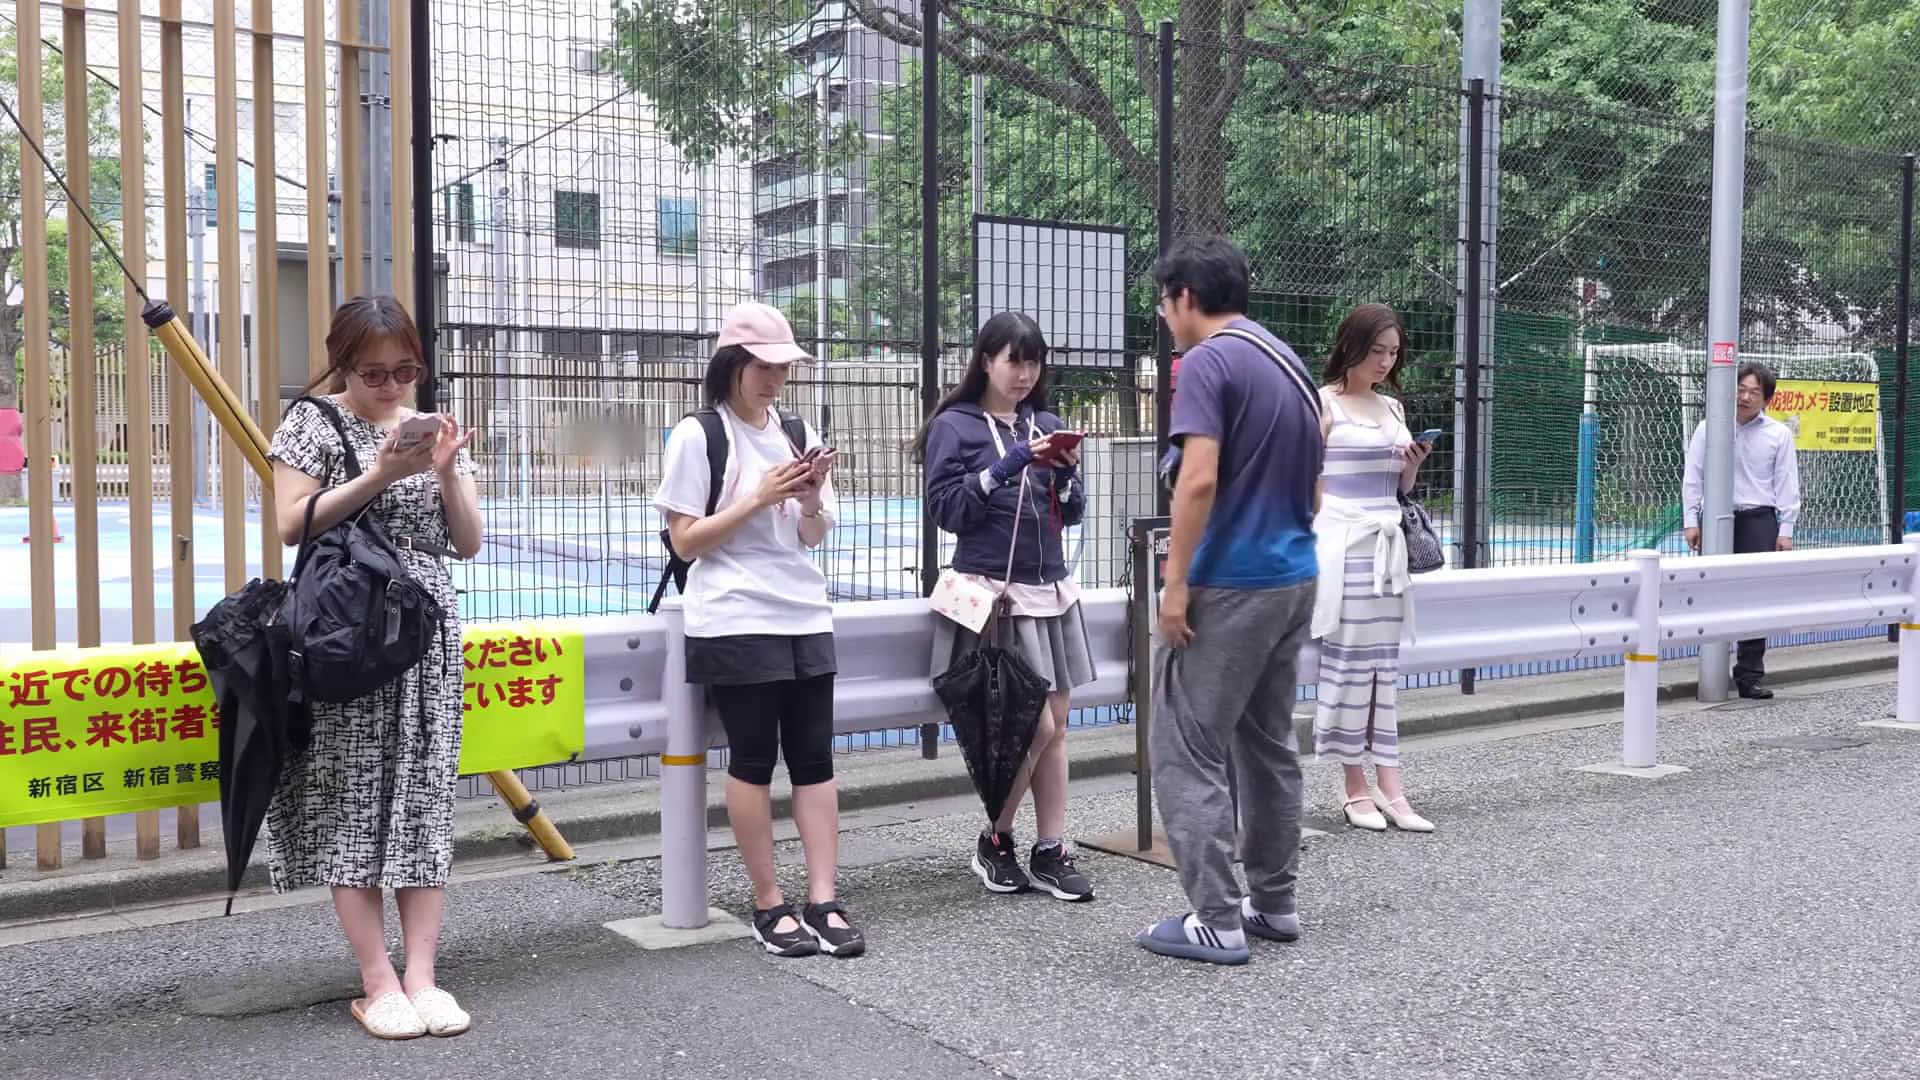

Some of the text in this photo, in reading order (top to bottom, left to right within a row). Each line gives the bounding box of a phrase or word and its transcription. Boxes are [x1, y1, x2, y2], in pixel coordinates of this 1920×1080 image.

[0, 659, 208, 708] 近での待ち
[28, 760, 220, 799] 新宿区 新宿警察
